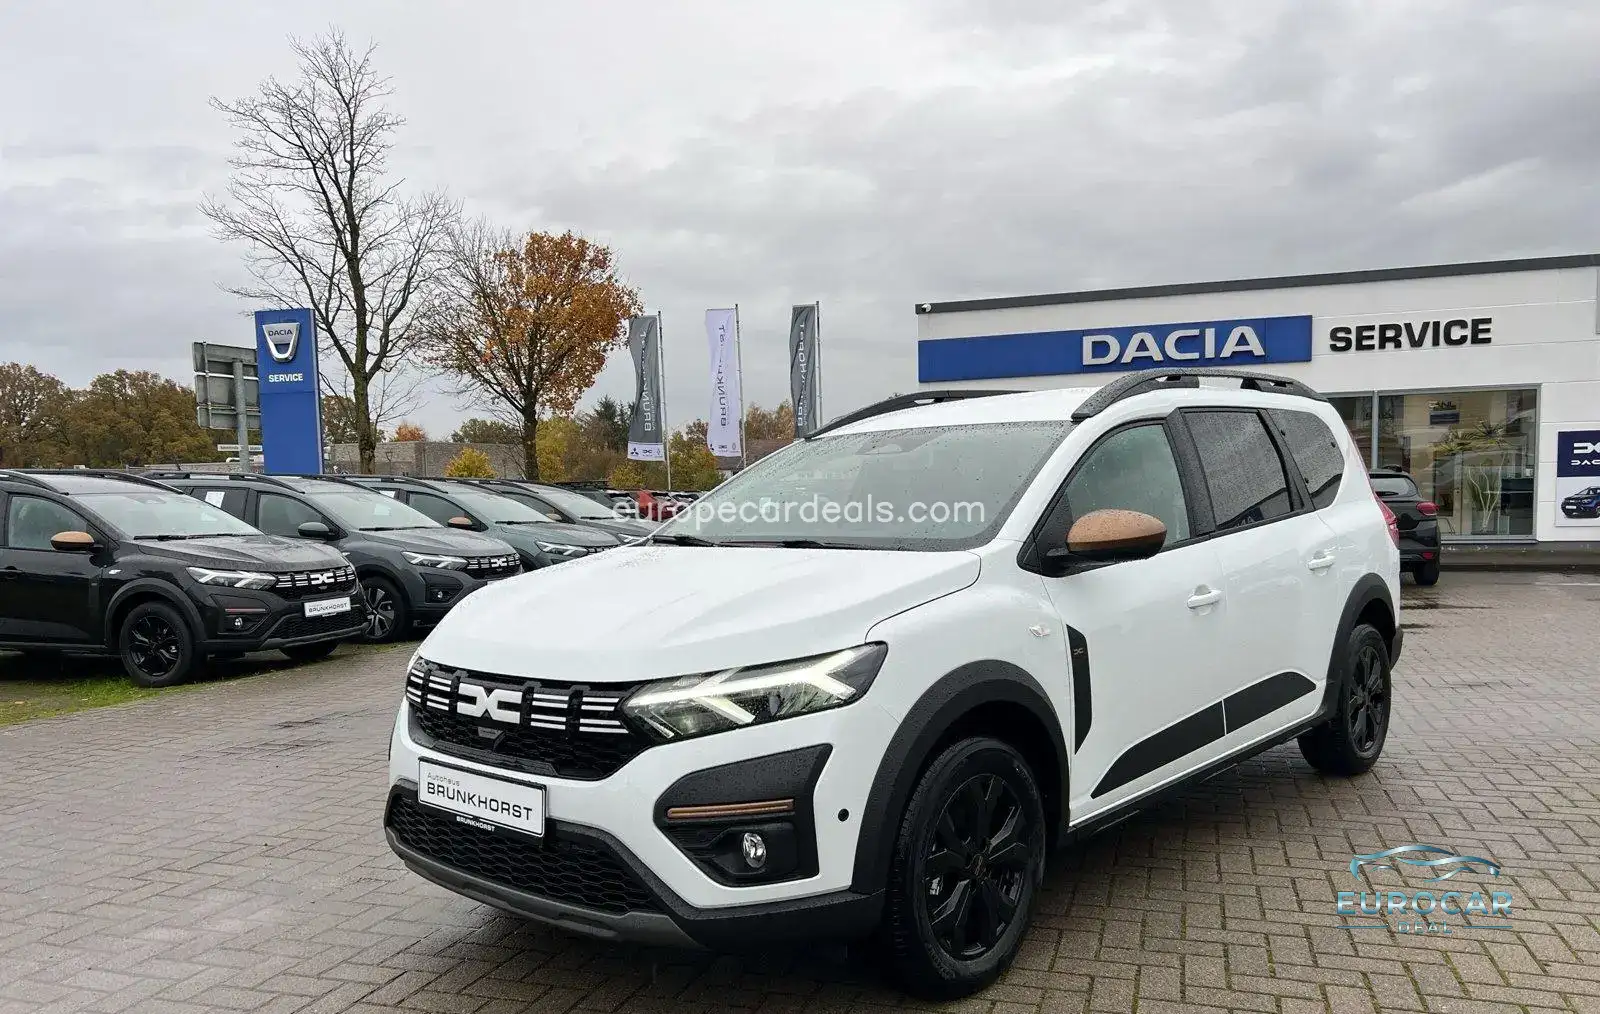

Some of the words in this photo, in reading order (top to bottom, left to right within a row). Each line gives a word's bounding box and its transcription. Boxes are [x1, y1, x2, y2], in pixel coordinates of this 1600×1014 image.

[268, 328, 293, 337] DACIA
[1328, 317, 1493, 352] SERVICE
[1082, 325, 1265, 365] DACIA
[268, 373, 304, 383] SERVICE
[308, 602, 348, 613] BRUNKHORST
[426, 772, 460, 787] Autohaus
[426, 782, 533, 821] BRUNKHORST
[456, 816, 496, 832] BRUNKHORST
